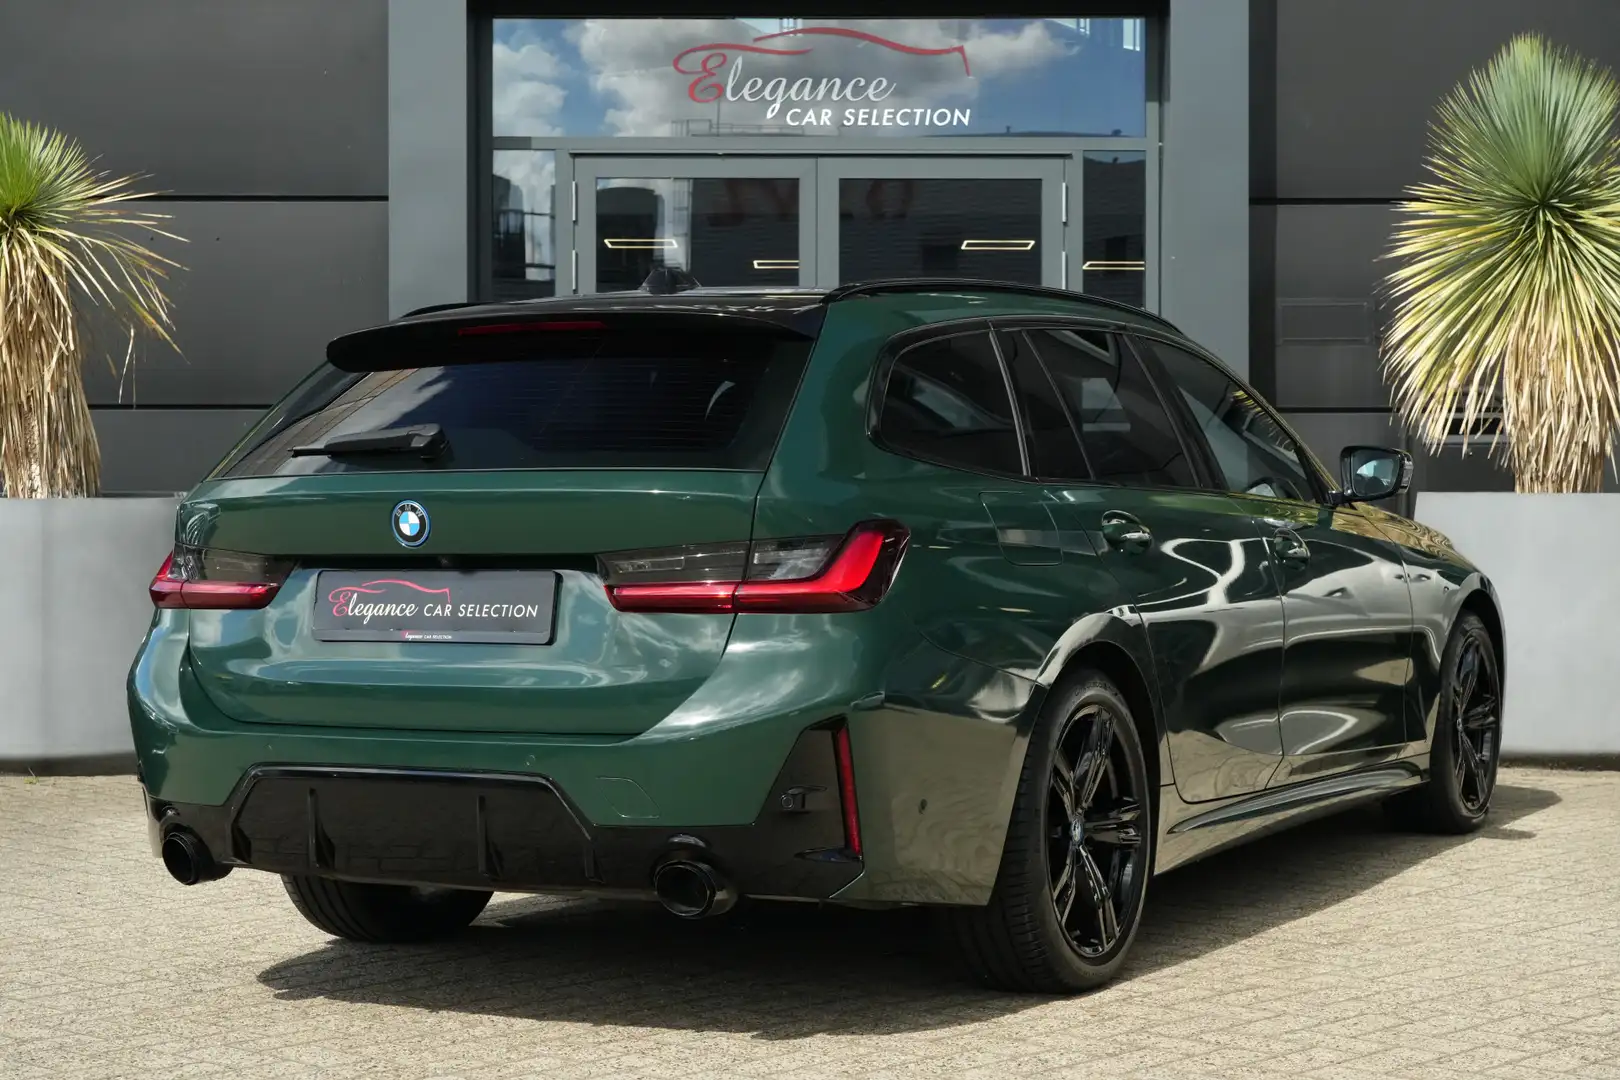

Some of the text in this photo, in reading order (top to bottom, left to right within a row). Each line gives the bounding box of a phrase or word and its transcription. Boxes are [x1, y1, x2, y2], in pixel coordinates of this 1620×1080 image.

[674, 45, 897, 119] Elegance
[786, 108, 971, 127] CAR SELECTION
[396, 504, 423, 517] BMW
[329, 588, 539, 625] Elegance CAR SELECTION
